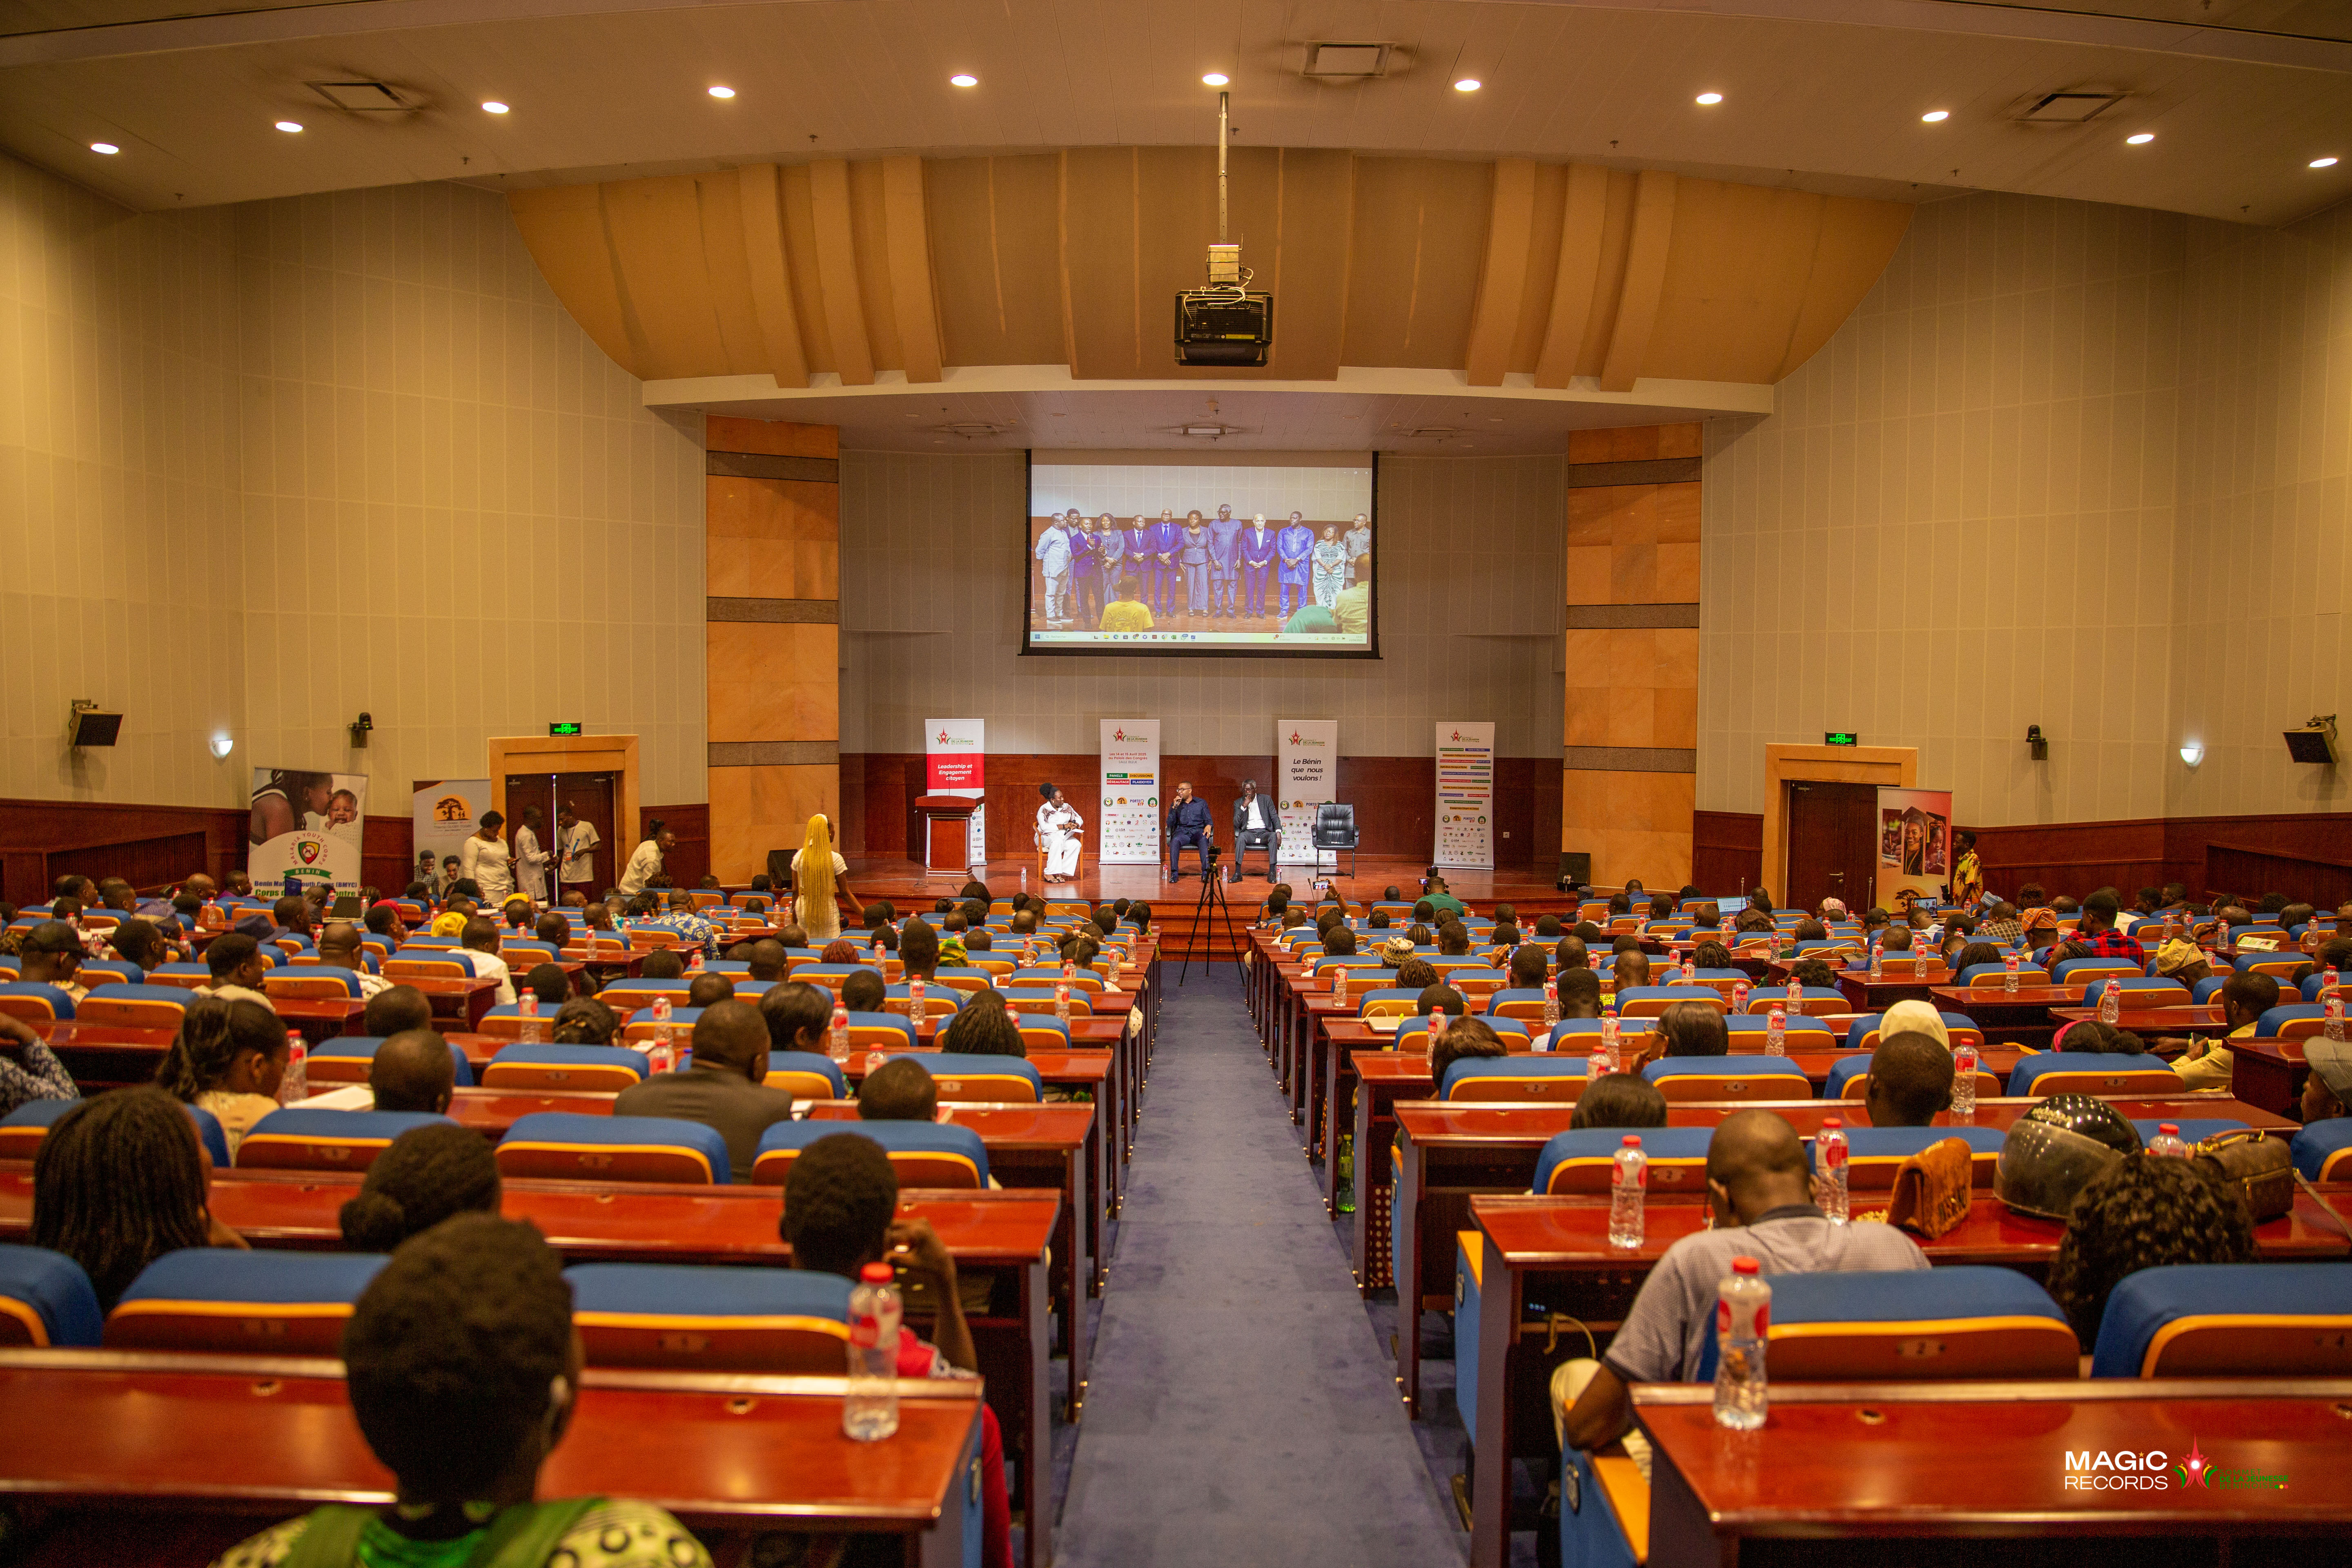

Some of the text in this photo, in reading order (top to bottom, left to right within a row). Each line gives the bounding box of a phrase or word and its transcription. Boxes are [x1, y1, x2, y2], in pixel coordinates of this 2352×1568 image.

[290, 832, 328, 865] MALARIA YOUTH CORPS
